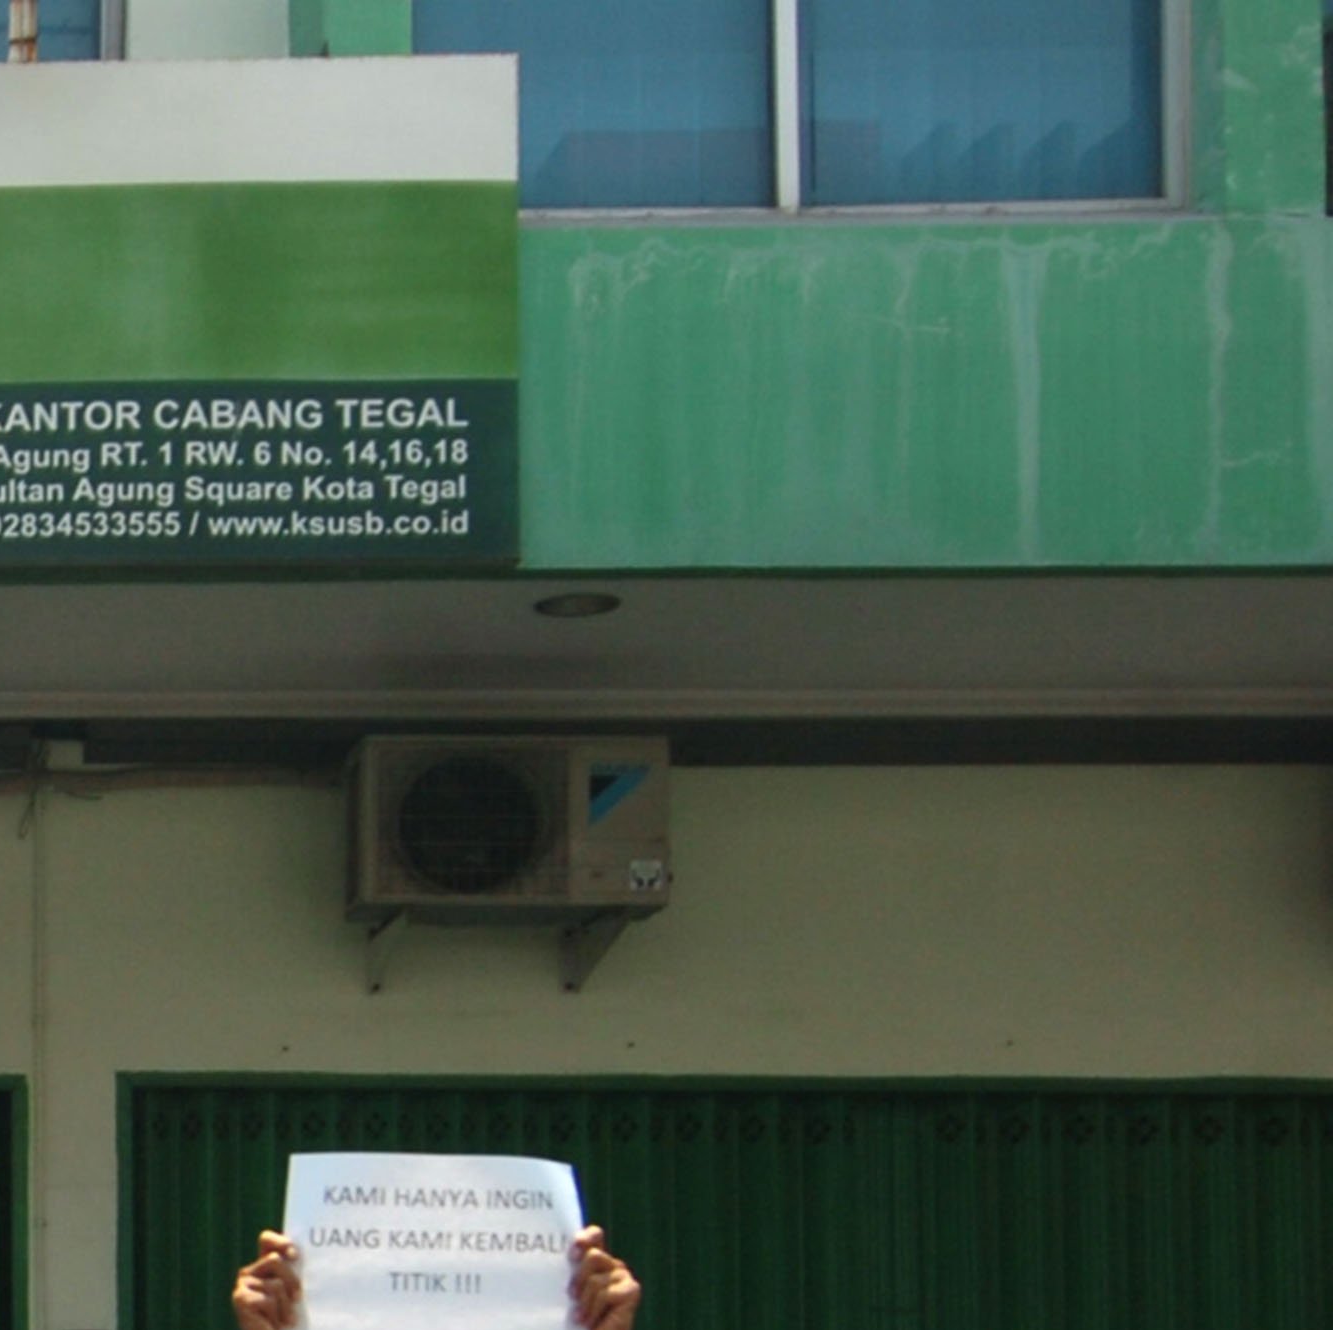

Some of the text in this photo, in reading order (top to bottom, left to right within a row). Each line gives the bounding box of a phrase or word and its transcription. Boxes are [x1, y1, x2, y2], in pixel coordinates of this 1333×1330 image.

[153, 398, 324, 431] CABANG
[335, 397, 470, 429] TEGAL
[100, 441, 148, 468] RT.
[159, 440, 173, 467] 1
[184, 440, 245, 467] RW.
[253, 440, 272, 467] 6
[280, 440, 332, 466] No.
[342, 438, 470, 471] 14,16,18
[73, 476, 176, 508] Agung
[183, 475, 294, 508] Square
[302, 475, 375, 501] Kota
[384, 473, 467, 505] Tegal
[188, 510, 201, 537] /
[207, 510, 471, 537] www.ksusb.co.id
[322, 1185, 555, 1211] KAMI HANYA INGIN
[308, 1226, 569, 1254] UANG KAMI KEMBALI
[388, 1271, 483, 1294] TITIK !!!
